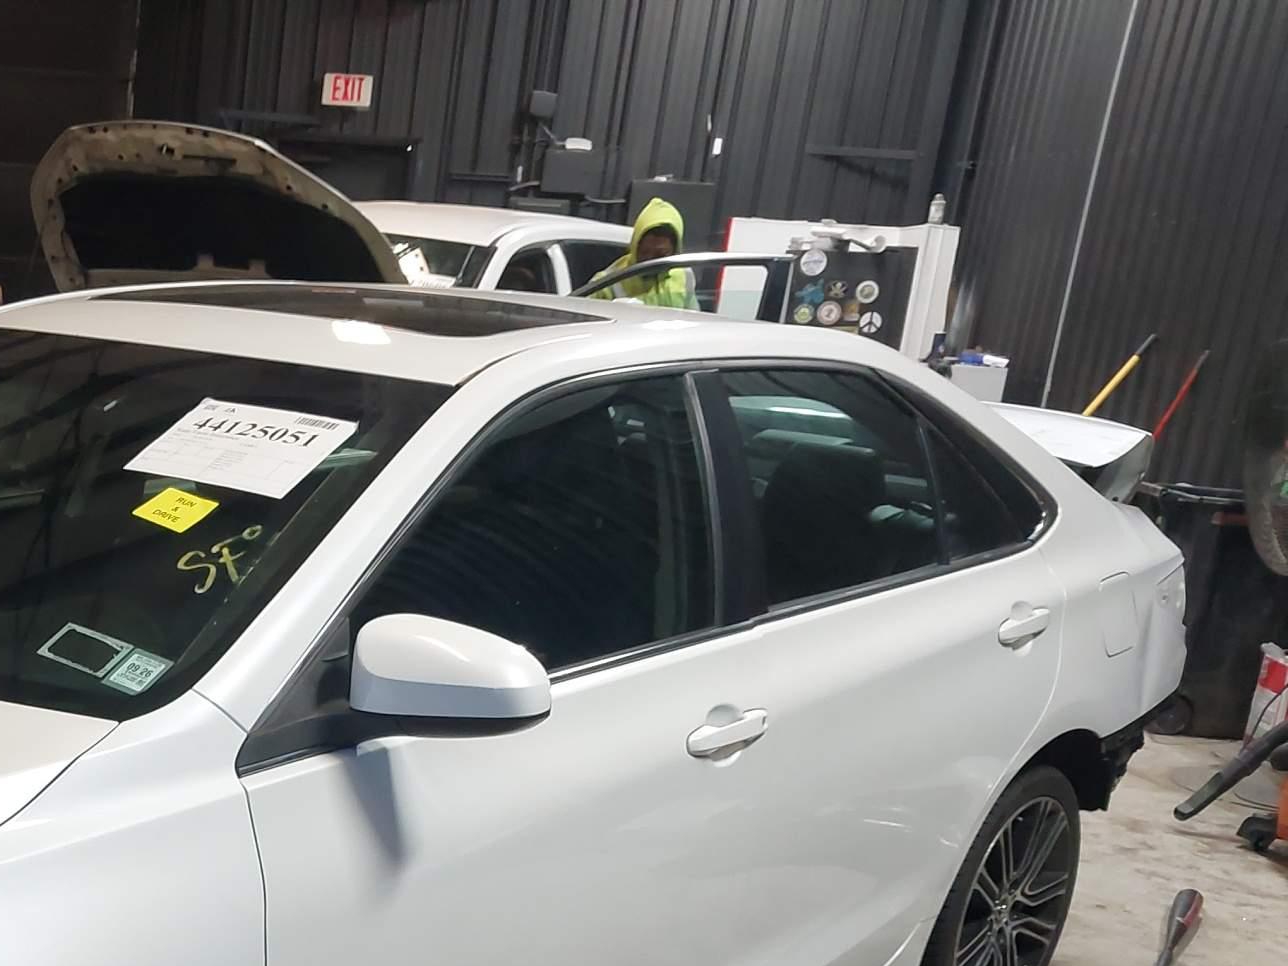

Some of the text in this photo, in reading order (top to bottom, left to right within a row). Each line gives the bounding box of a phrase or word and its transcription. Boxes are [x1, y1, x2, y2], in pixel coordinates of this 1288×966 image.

[331, 75, 365, 102] EXIT
[192, 416, 321, 448] 44125051
[176, 497, 197, 507] RUN
[153, 509, 180, 522] DRIVE
